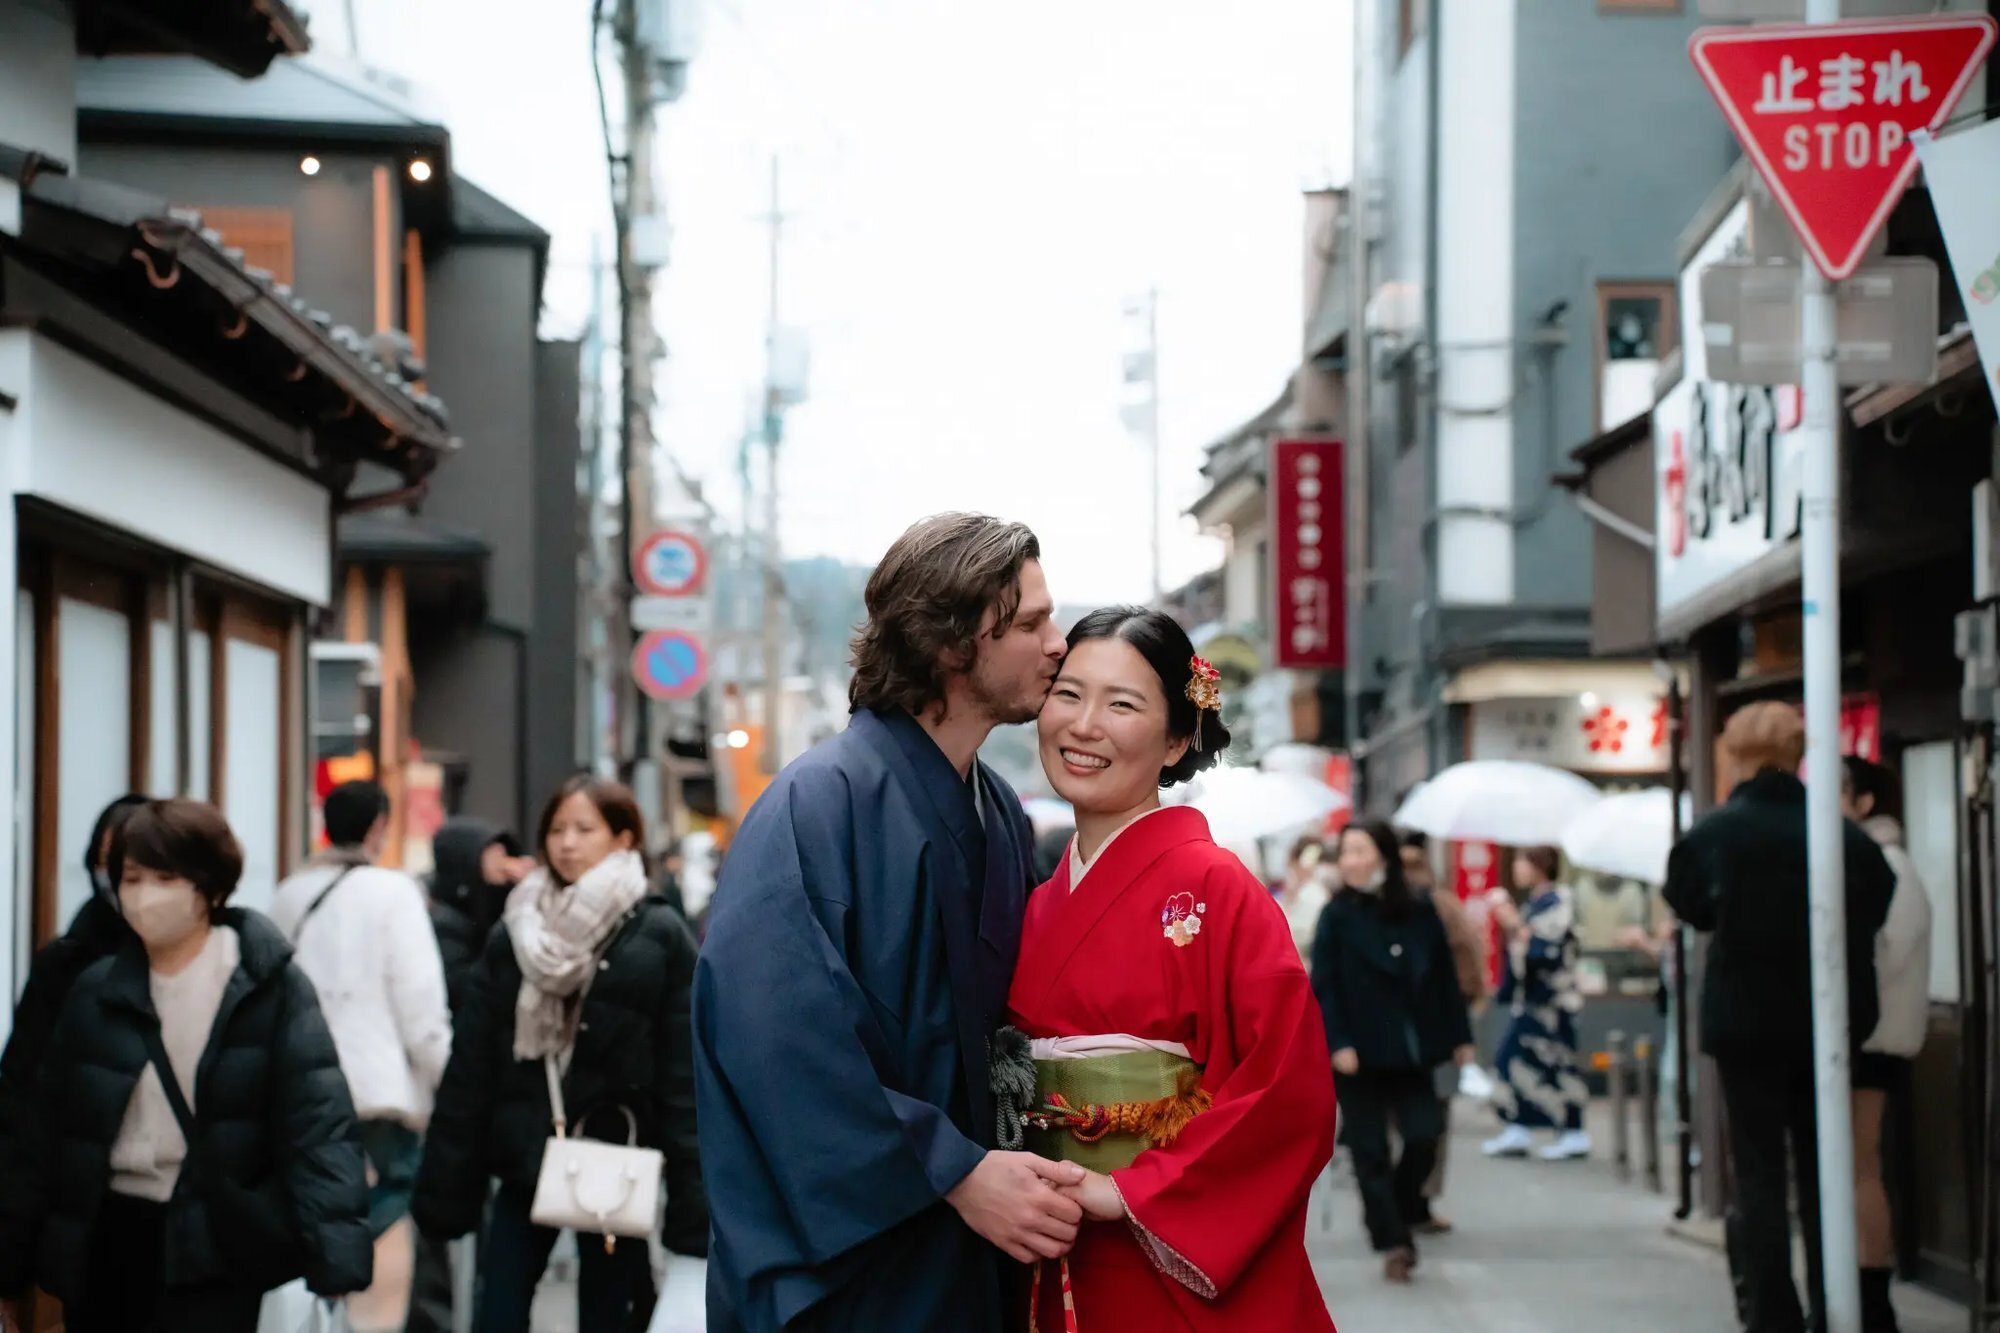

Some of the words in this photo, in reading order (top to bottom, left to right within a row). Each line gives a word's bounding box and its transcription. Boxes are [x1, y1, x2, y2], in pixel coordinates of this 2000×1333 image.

[1753, 49, 1931, 114] 止まれ
[1783, 120, 1904, 171] STOP
